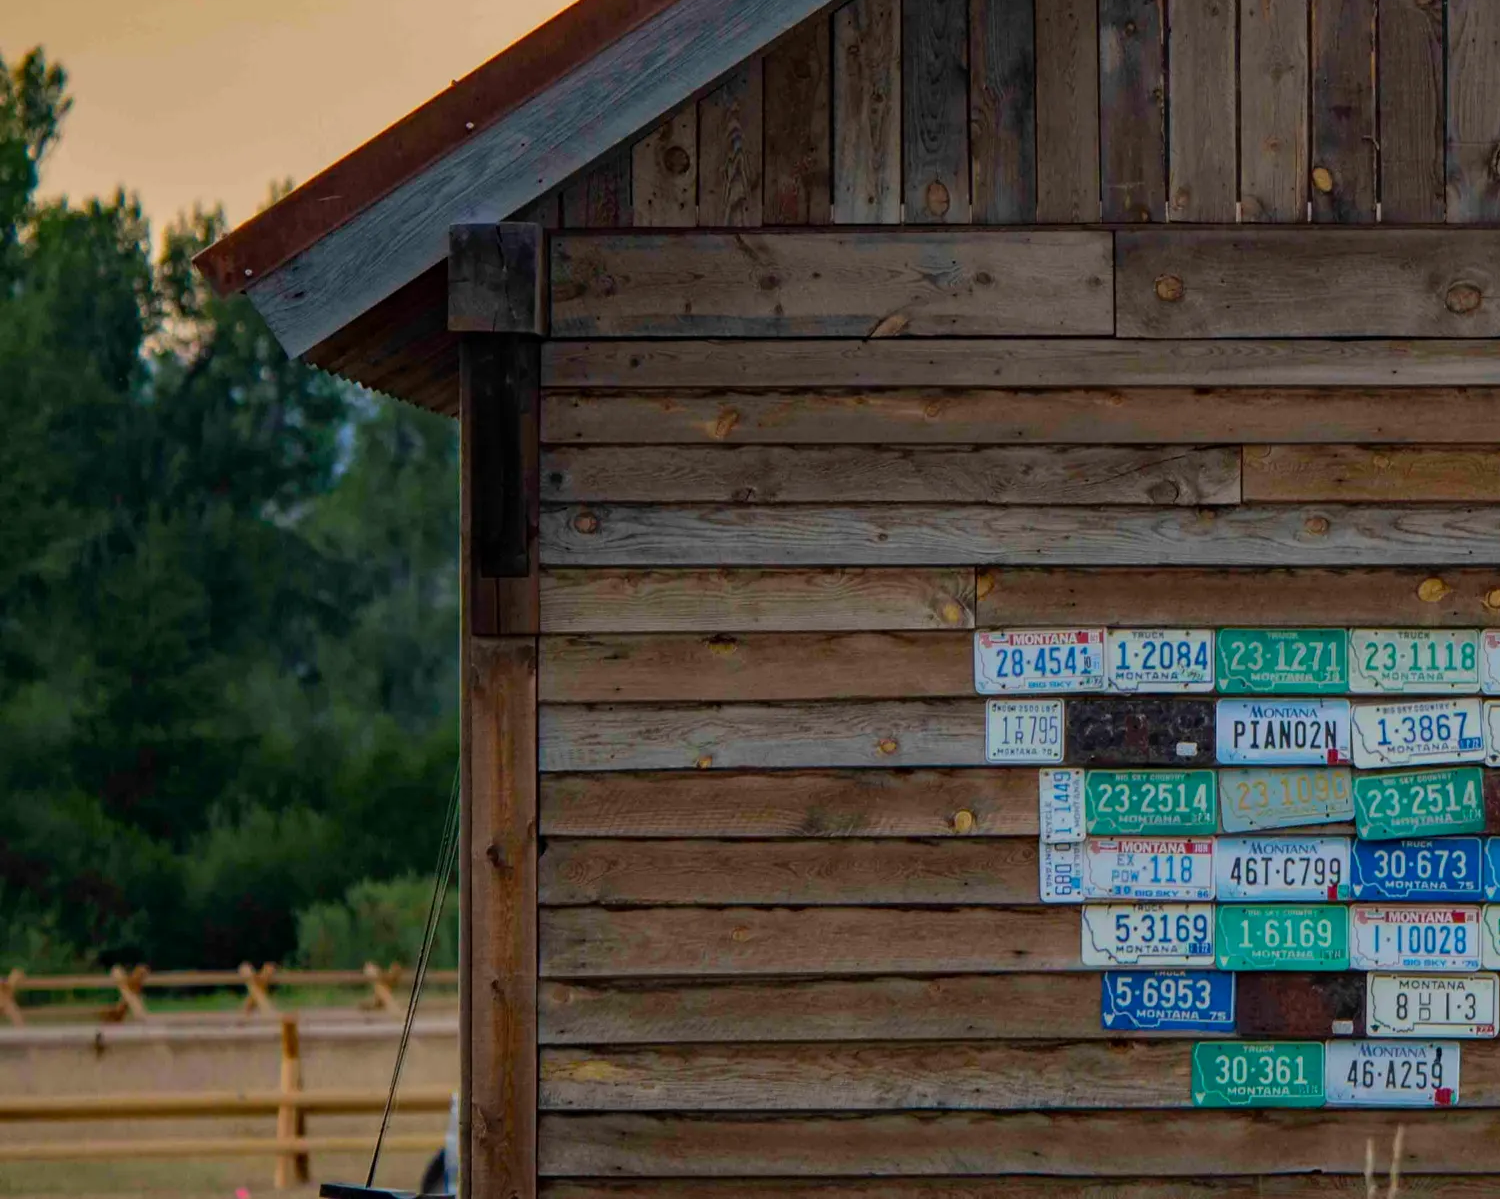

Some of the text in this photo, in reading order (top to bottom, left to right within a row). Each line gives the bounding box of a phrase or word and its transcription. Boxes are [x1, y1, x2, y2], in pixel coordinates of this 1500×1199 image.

[1014, 633, 1077, 645] MONTANA
[1132, 631, 1164, 639] TRUCK
[1399, 631, 1430, 639] TRUCK
[1115, 672, 1178, 680] MONTANA
[1250, 673, 1313, 681] MONTANA
[1381, 672, 1444, 681] MONTANA
[1250, 705, 1318, 718] MONTANA
[1387, 743, 1449, 754] MONTANA
[1121, 842, 1186, 853] MONTANA
[1249, 842, 1318, 854] MONTANA
[1117, 854, 1134, 866] EX
[1111, 870, 1139, 882] POW
[1385, 880, 1447, 889] MONTANA
[1134, 889, 1153, 897] BIG
[1155, 889, 1179, 897] SKY
[1388, 911, 1453, 923] MONTANA
[1116, 945, 1178, 953] MONTANA
[1252, 950, 1313, 958] MONTANA
[1399, 980, 1465, 990] MONTANA
[1136, 1009, 1199, 1019] MONTANA
[1243, 1045, 1275, 1053] TRUCK
[1358, 1044, 1426, 1058] MONTANA
[1227, 1086, 1290, 1095] MONTANA
